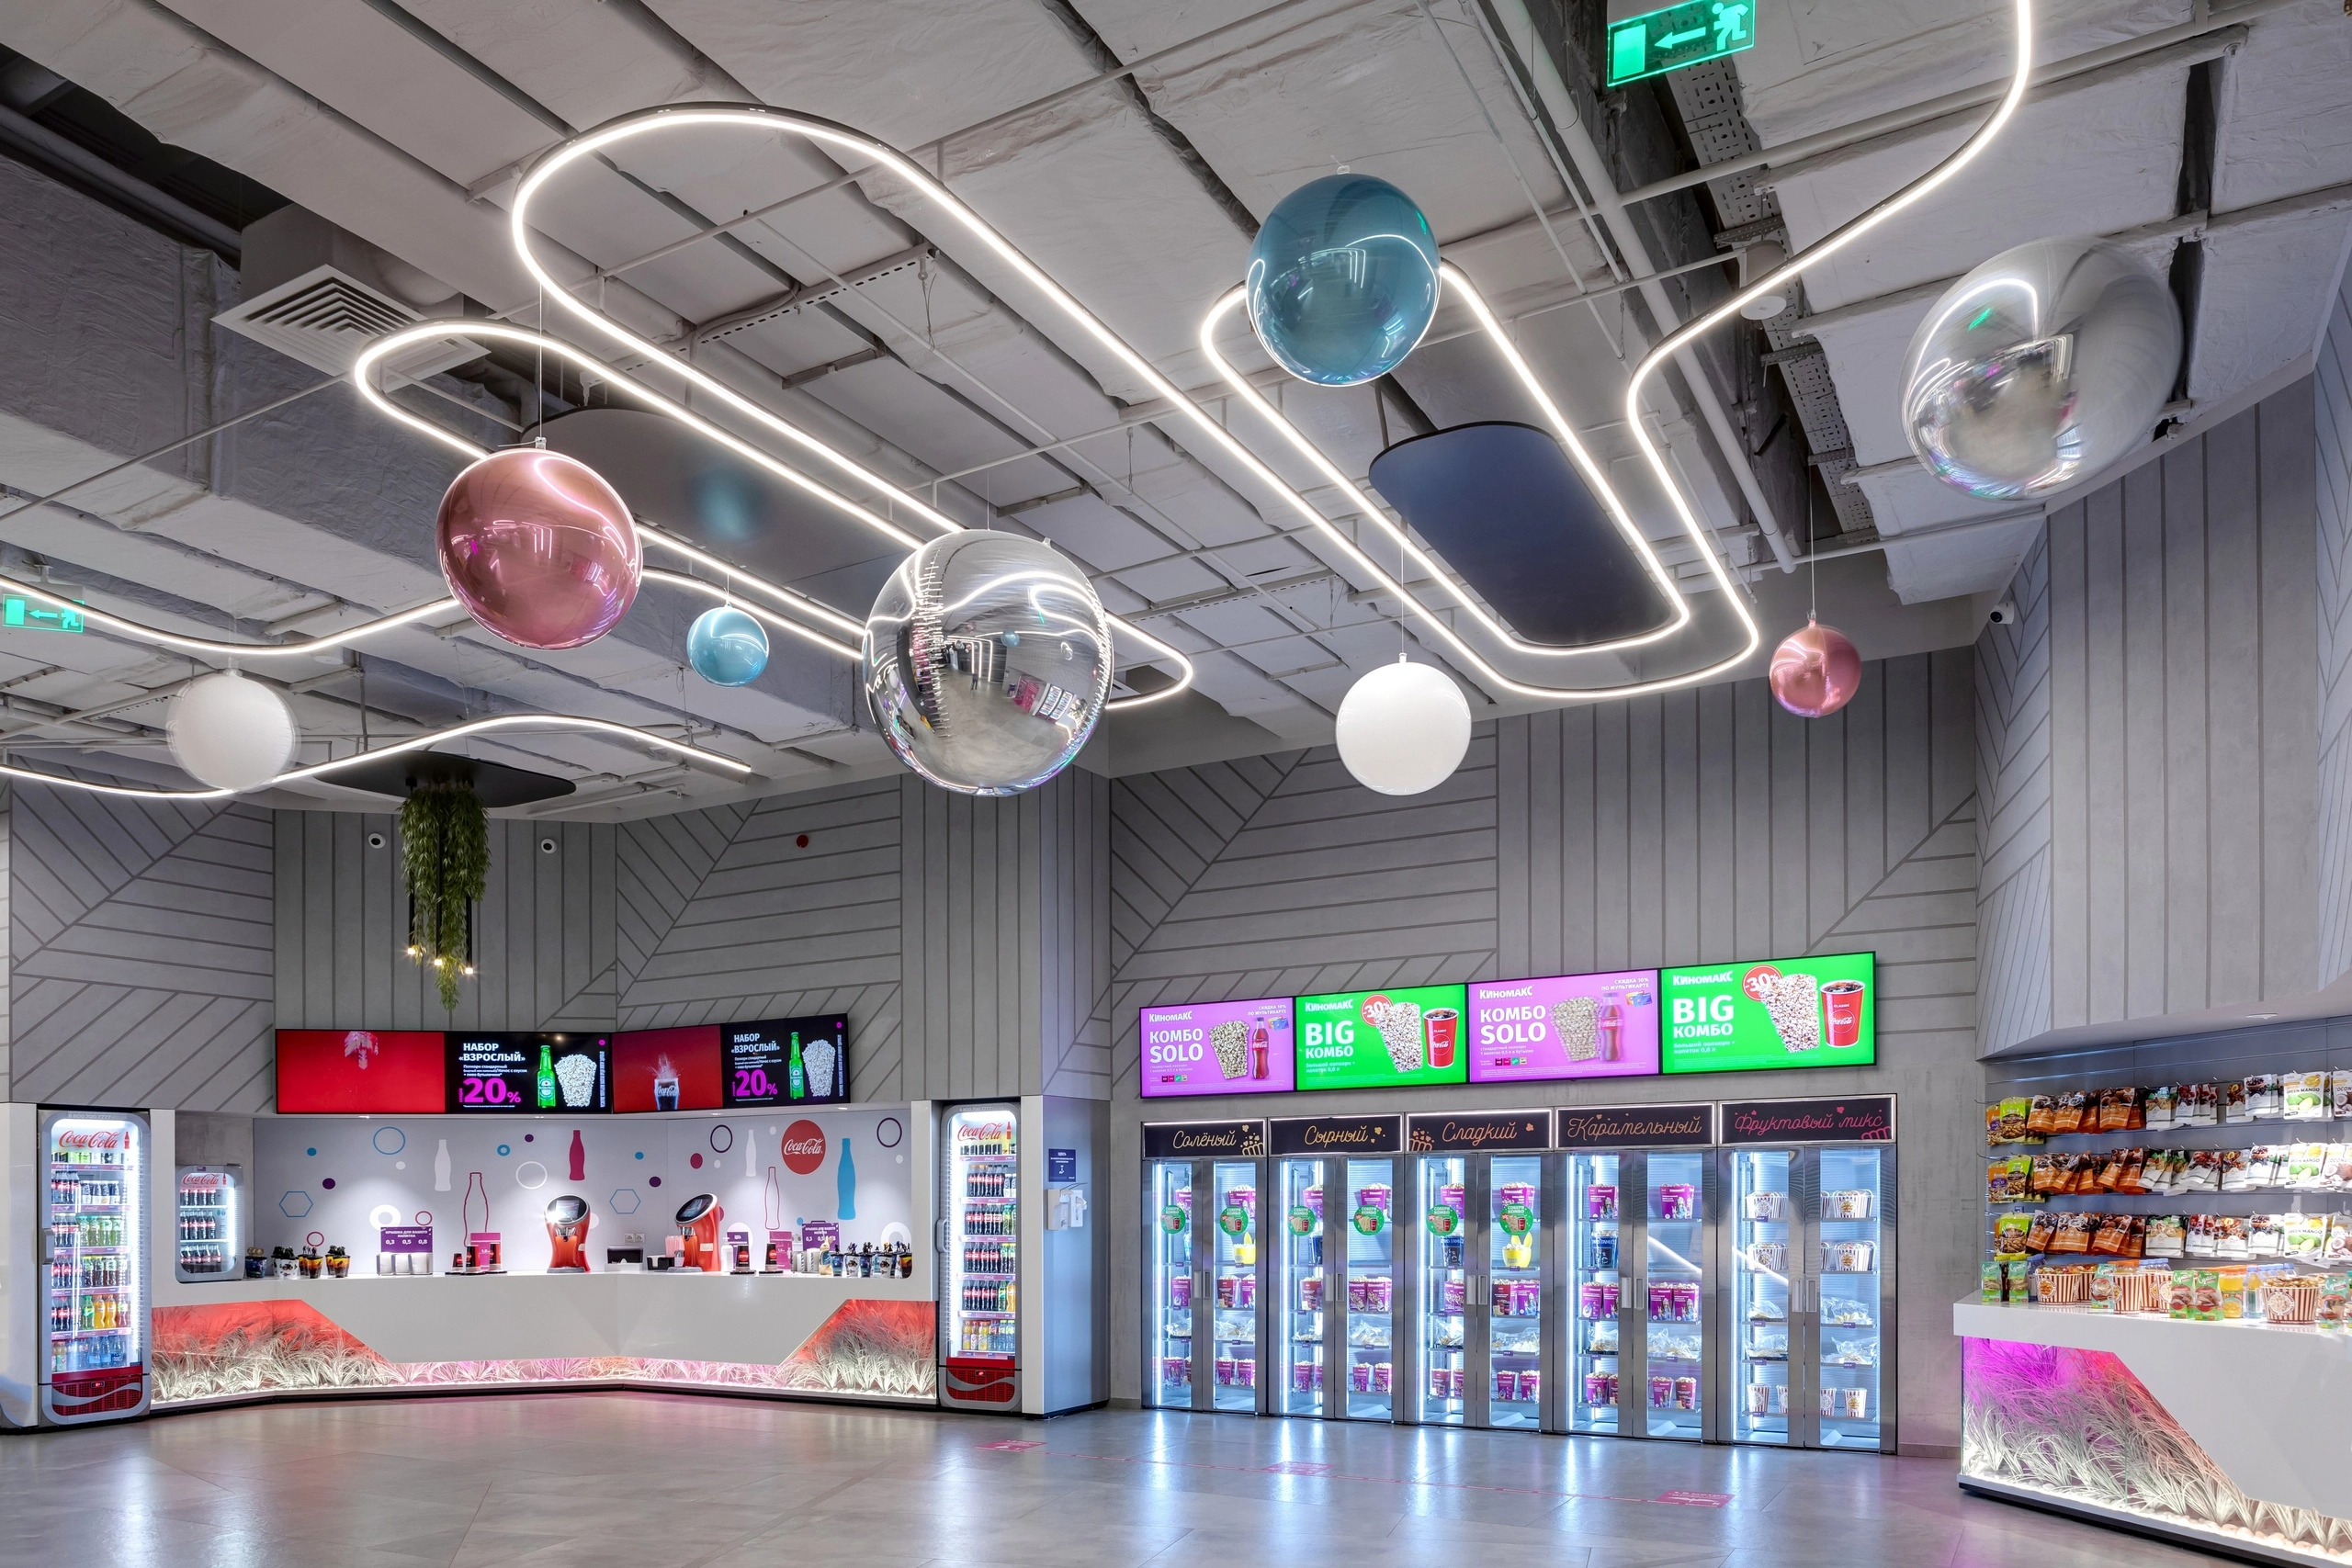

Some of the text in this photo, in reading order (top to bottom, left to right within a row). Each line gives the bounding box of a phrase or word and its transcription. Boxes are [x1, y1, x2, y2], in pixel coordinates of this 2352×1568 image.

[1480, 1005, 1546, 1023] КОМБО
[1673, 995, 1734, 1023] BIG
[733, 1032, 760, 1043] НАБОР
[1150, 1028, 1204, 1043] КОМБО
[1305, 1020, 1354, 1046] BIG
[1480, 1021, 1546, 1045] SOLO
[1674, 1022, 1733, 1039] КОМБО
[463, 1043, 499, 1051] НАБОР
[730, 1041, 780, 1054] «ВЗРОСЛЫЙ»
[1150, 1043, 1204, 1063] SOLO
[1306, 1045, 1353, 1059] КОМБО
[458, 1052, 526, 1062] «ВЗРОСЛЫЙ»
[463, 1077, 522, 1103] 20%
[735, 1069, 778, 1097] 20%
[957, 1122, 1003, 1141] Coca-Cola
[1567, 1116, 1702, 1141] Карамельный
[1735, 1112, 1883, 1137] Фруктовый микс
[58, 1130, 120, 1149] Coca-Cola
[1172, 1128, 1237, 1149] Солёный
[1305, 1125, 1368, 1148] Сырный
[1442, 1122, 1518, 1148] Сладкий
[784, 1138, 823, 1156] Coca-Cola
[182, 1173, 220, 1185] Coca-Cola
